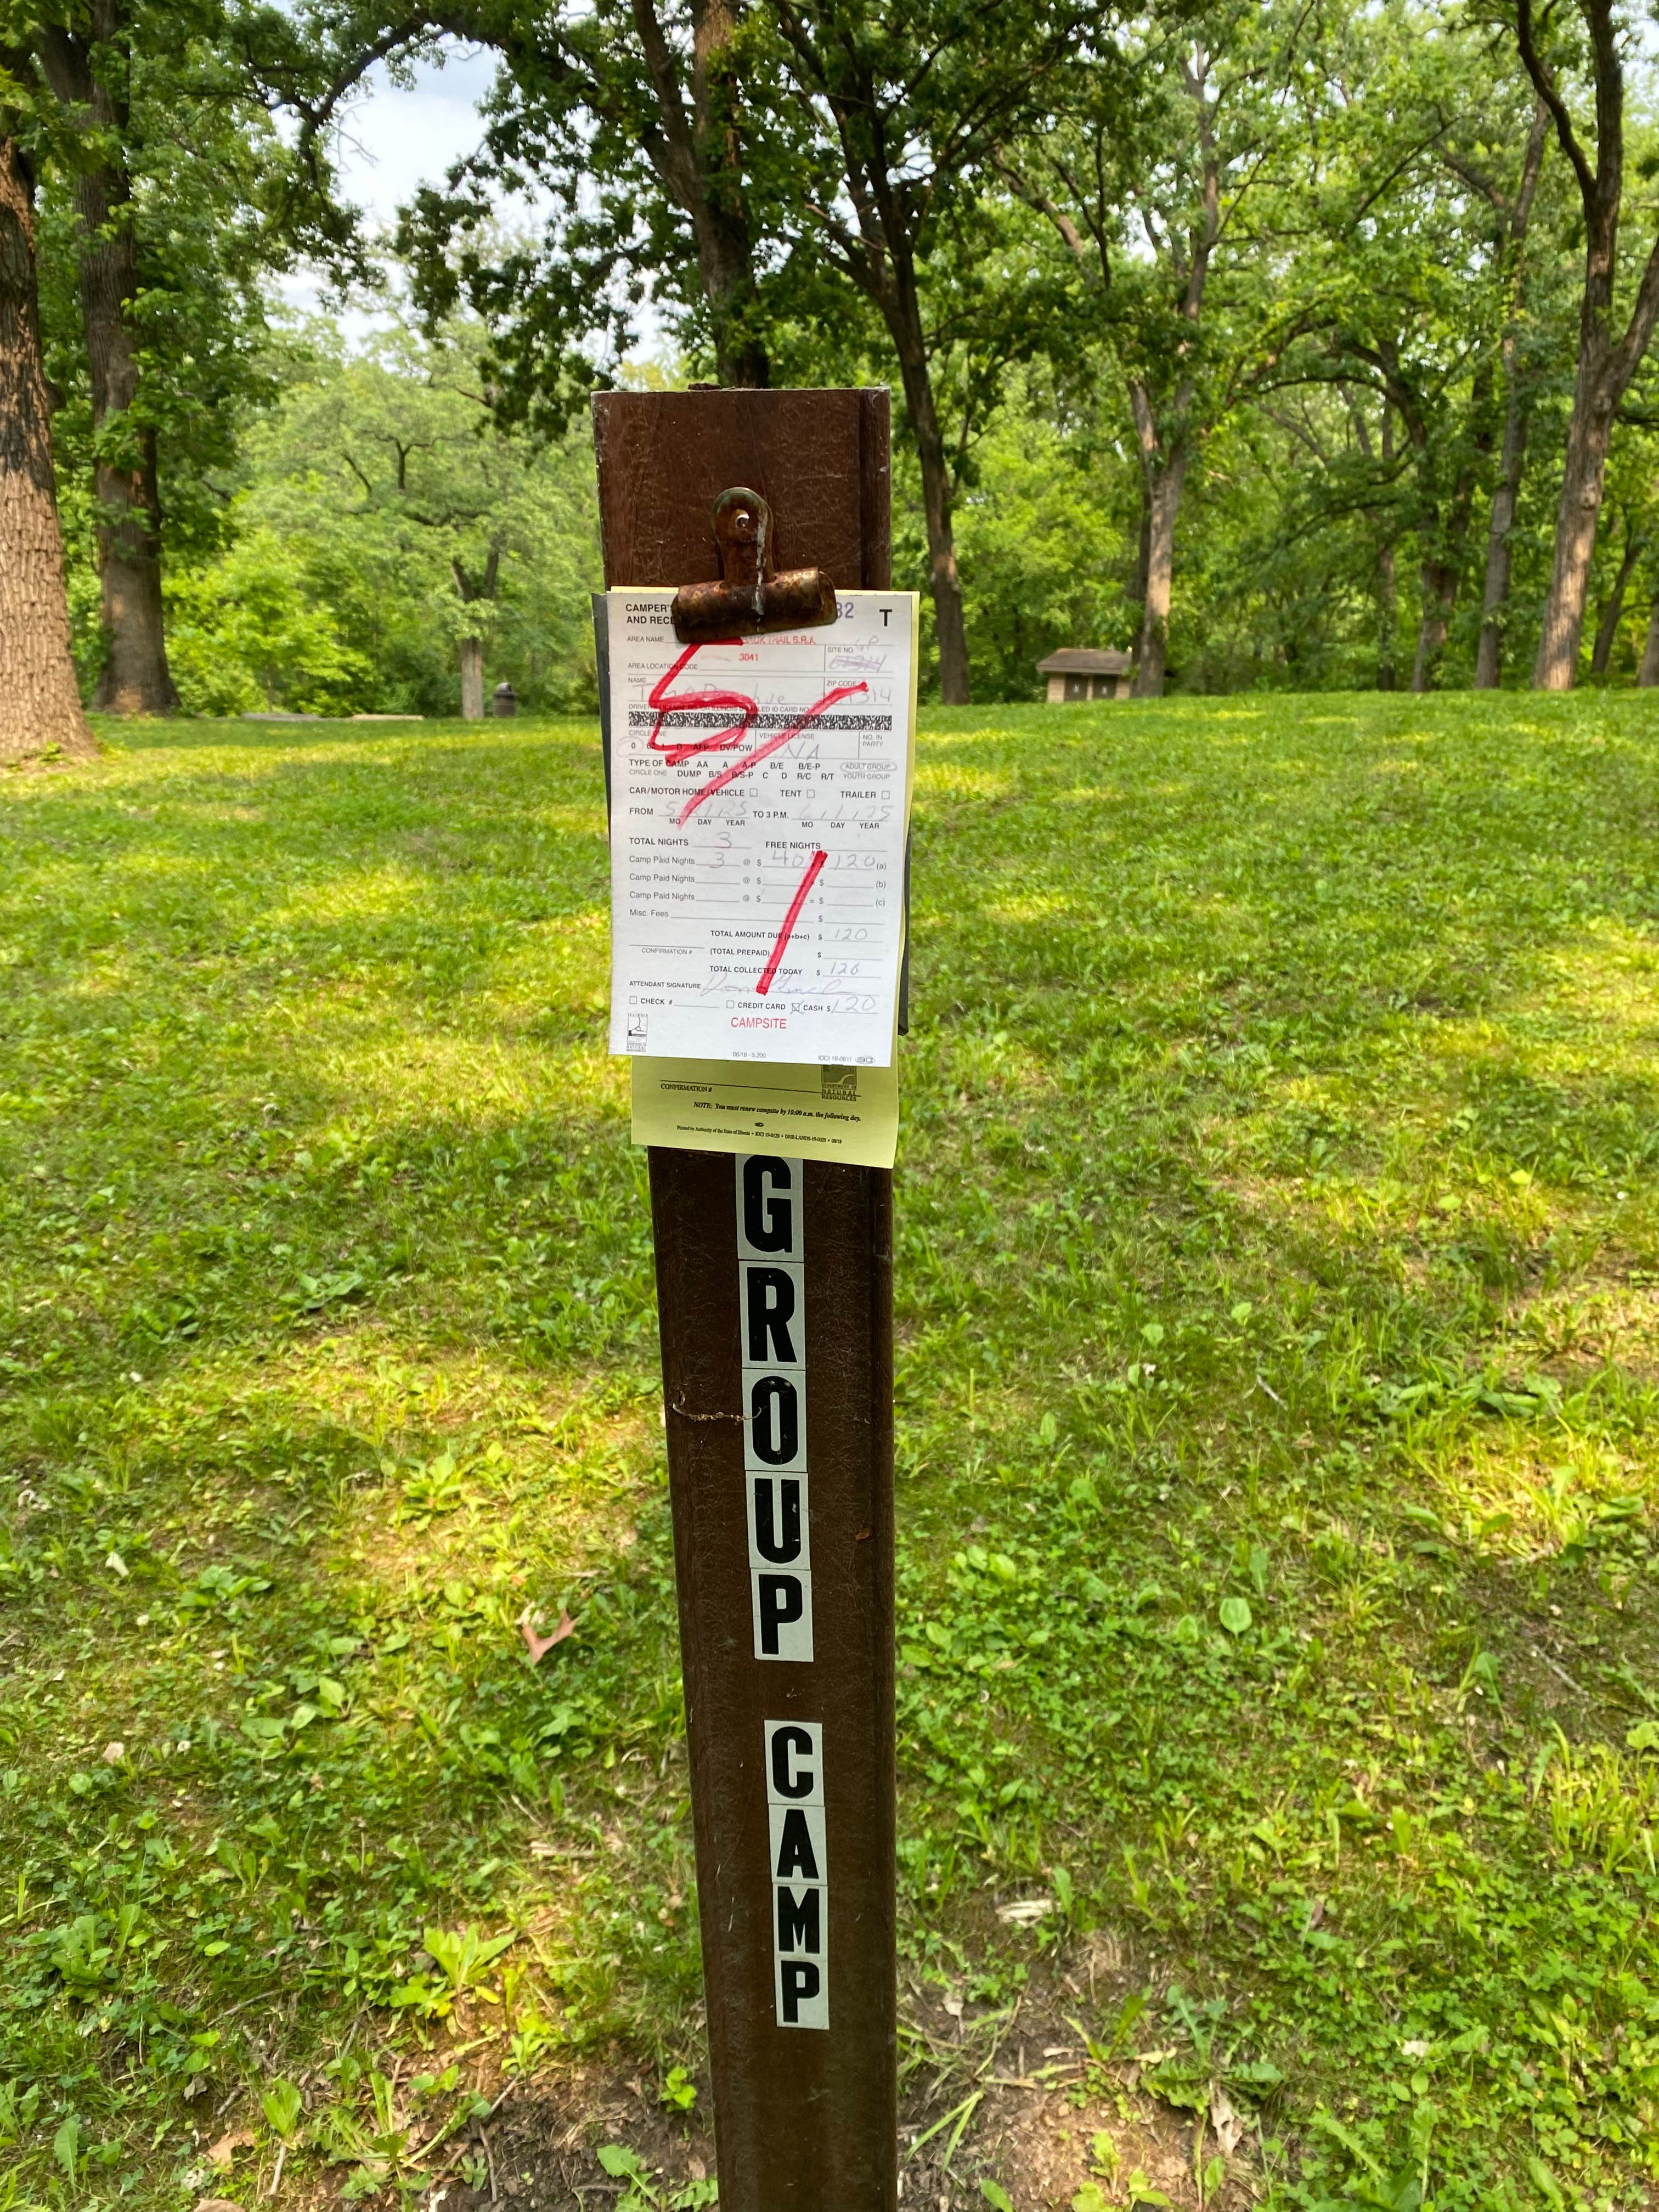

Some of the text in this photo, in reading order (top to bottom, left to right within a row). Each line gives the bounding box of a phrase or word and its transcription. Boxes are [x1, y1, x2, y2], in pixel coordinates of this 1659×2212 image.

[626, 604, 672, 612] CAMPER'
[879, 610, 892, 627] T
[672, 857, 695, 865] Nights
[672, 875, 695, 883] Nights
[731, 1017, 787, 1029] CAMPSITE
[661, 1084, 707, 1092] CONFIRMATION
[824, 1113, 849, 1121] following
[743, 1154, 803, 1655] GROUP
[772, 1726, 819, 2023] CAMP
